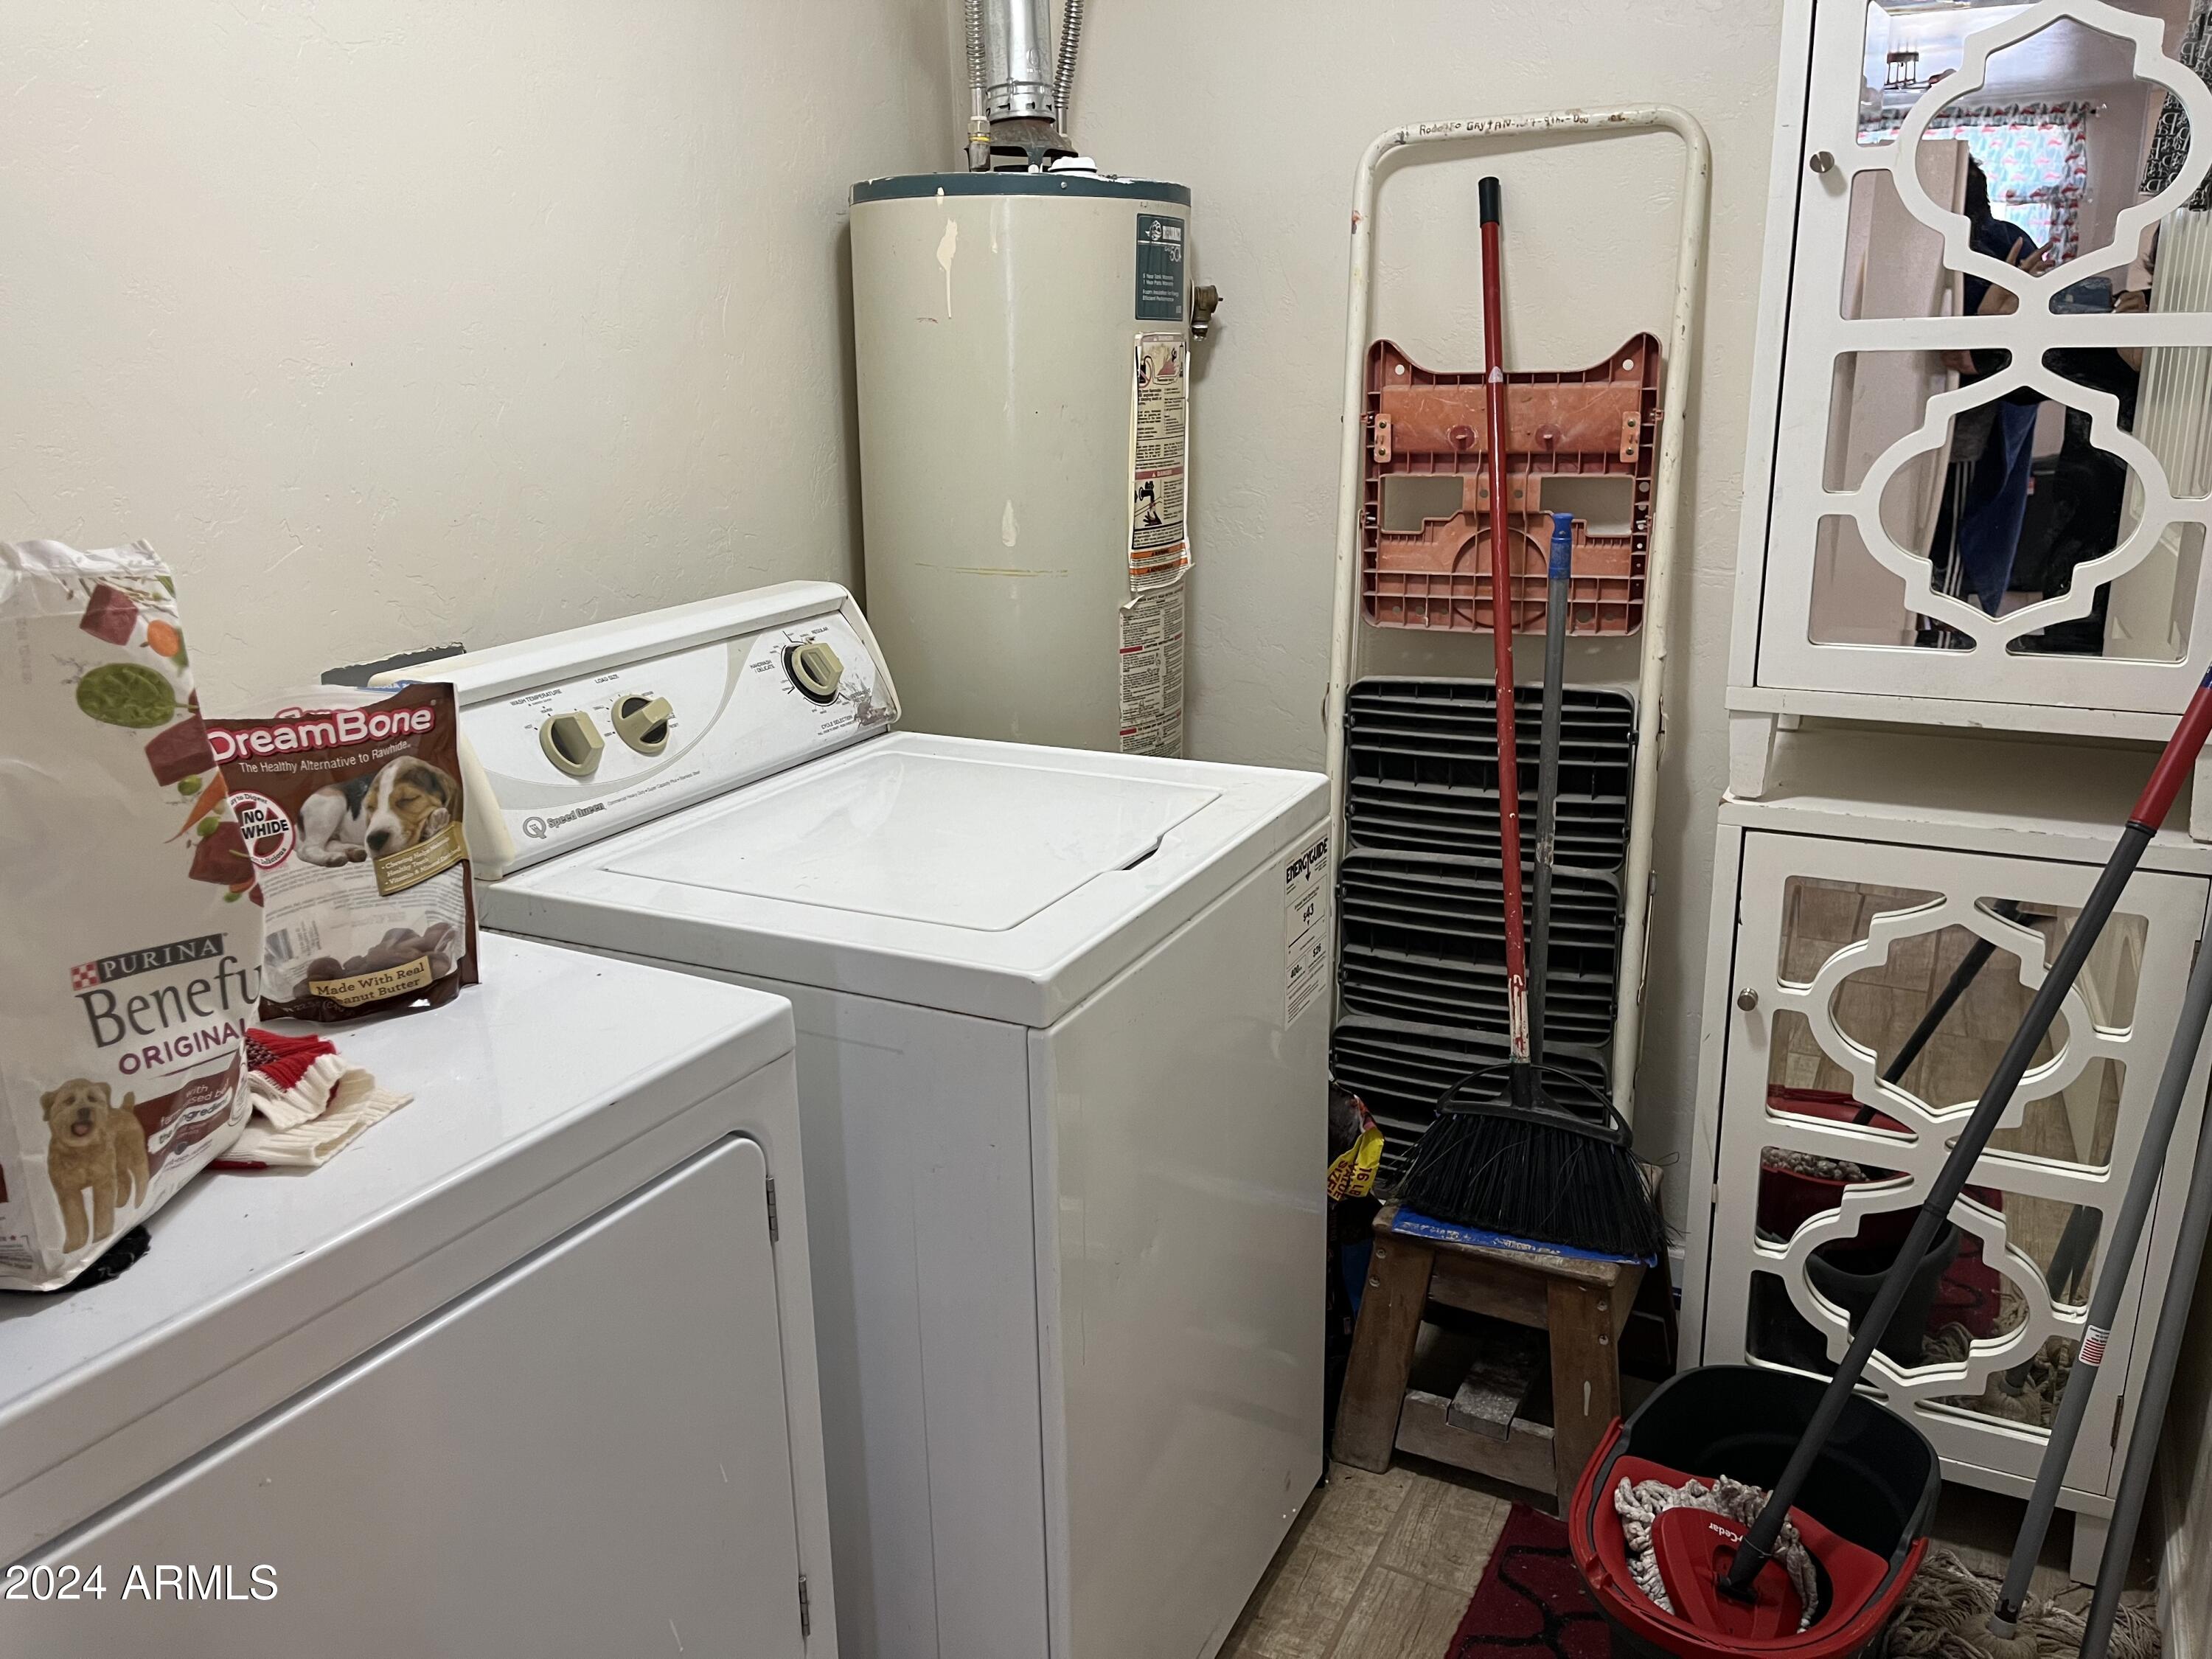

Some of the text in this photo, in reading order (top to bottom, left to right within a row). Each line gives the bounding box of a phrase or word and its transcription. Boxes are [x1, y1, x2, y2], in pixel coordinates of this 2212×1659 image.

[525, 689, 563, 701] TEMPERATURE
[206, 708, 434, 762] DreamBone
[238, 762, 258, 773] The
[260, 760, 297, 774] Healthy
[300, 756, 357, 772] Alternative
[358, 753, 369, 764] to
[243, 810, 264, 824] NO
[546, 810, 577, 828] Speed
[575, 803, 605, 818] Queen
[385, 856, 413, 869] Chewing
[387, 865, 412, 877] Healthy
[100, 938, 218, 980] PURINA
[316, 962, 425, 996] Made With Real
[379, 978, 421, 995] Butter
[1357, 1167, 1372, 1181] 16
